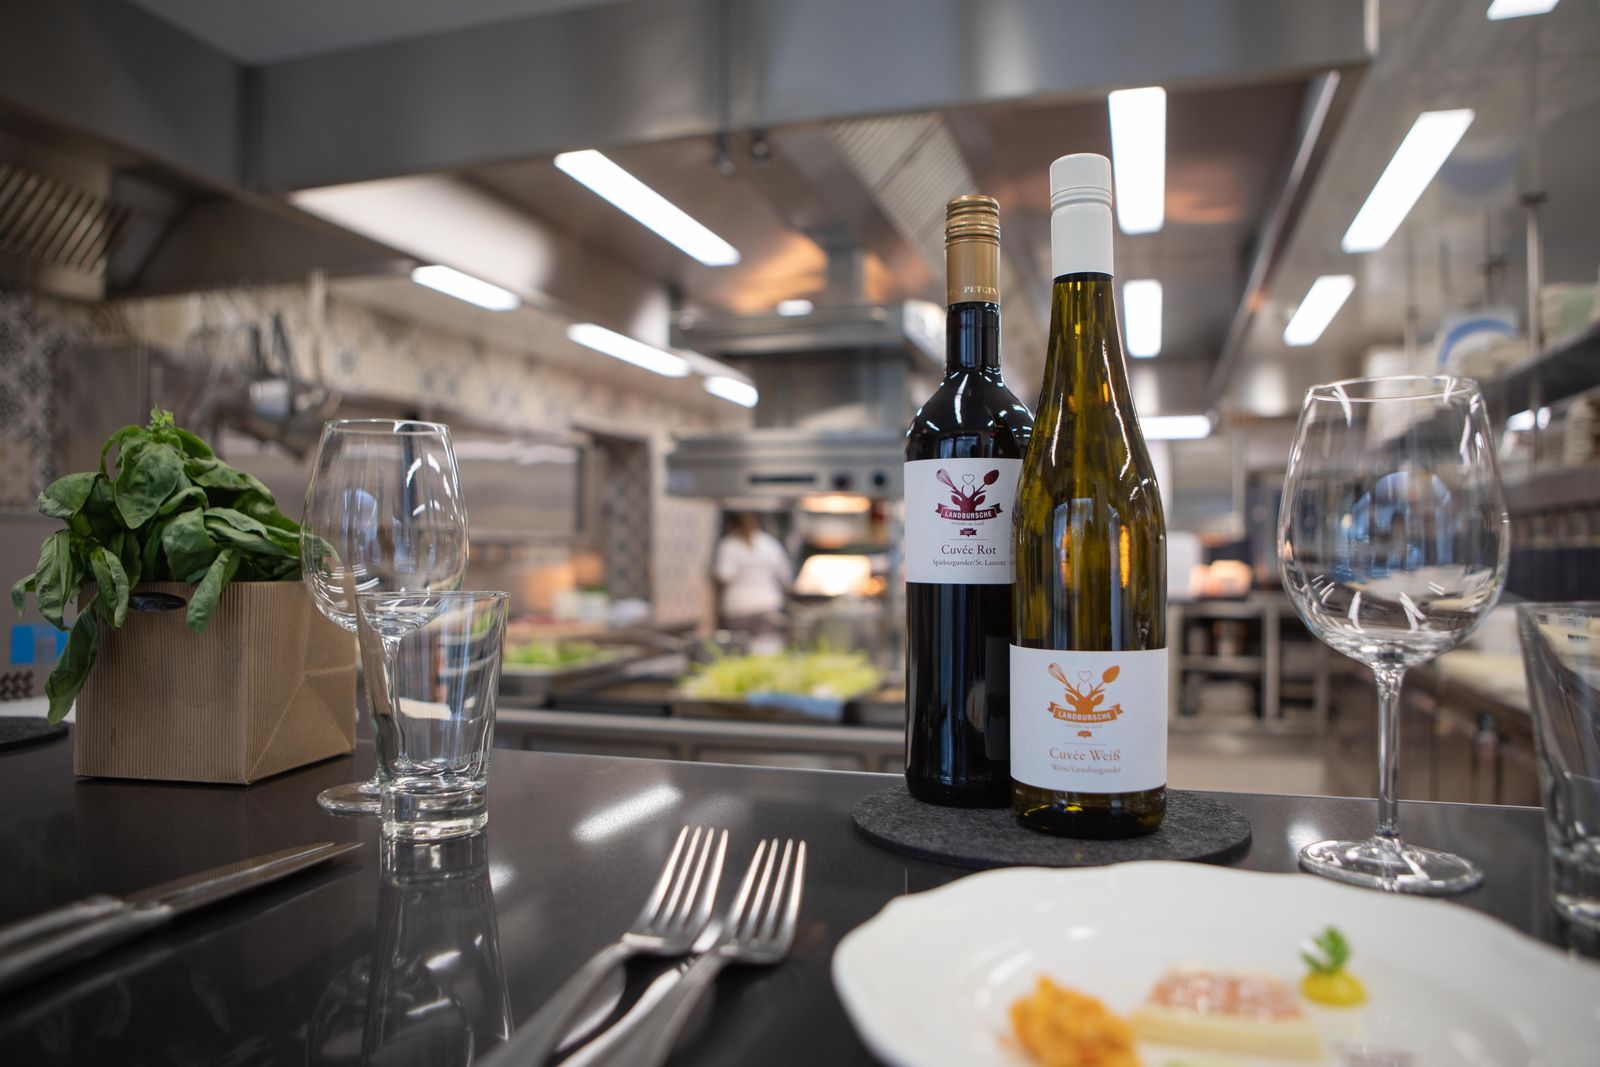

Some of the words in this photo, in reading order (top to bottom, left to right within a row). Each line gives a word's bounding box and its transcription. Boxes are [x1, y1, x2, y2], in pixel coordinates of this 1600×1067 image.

[944, 510, 993, 519] LANDBURSCHE
[941, 544, 974, 555] Cuvée
[977, 544, 997, 555] Rot
[1058, 710, 1112, 720] LANDBURSCHE
[1049, 747, 1086, 761] Cuvée
[1089, 747, 1121, 761] Weiß
